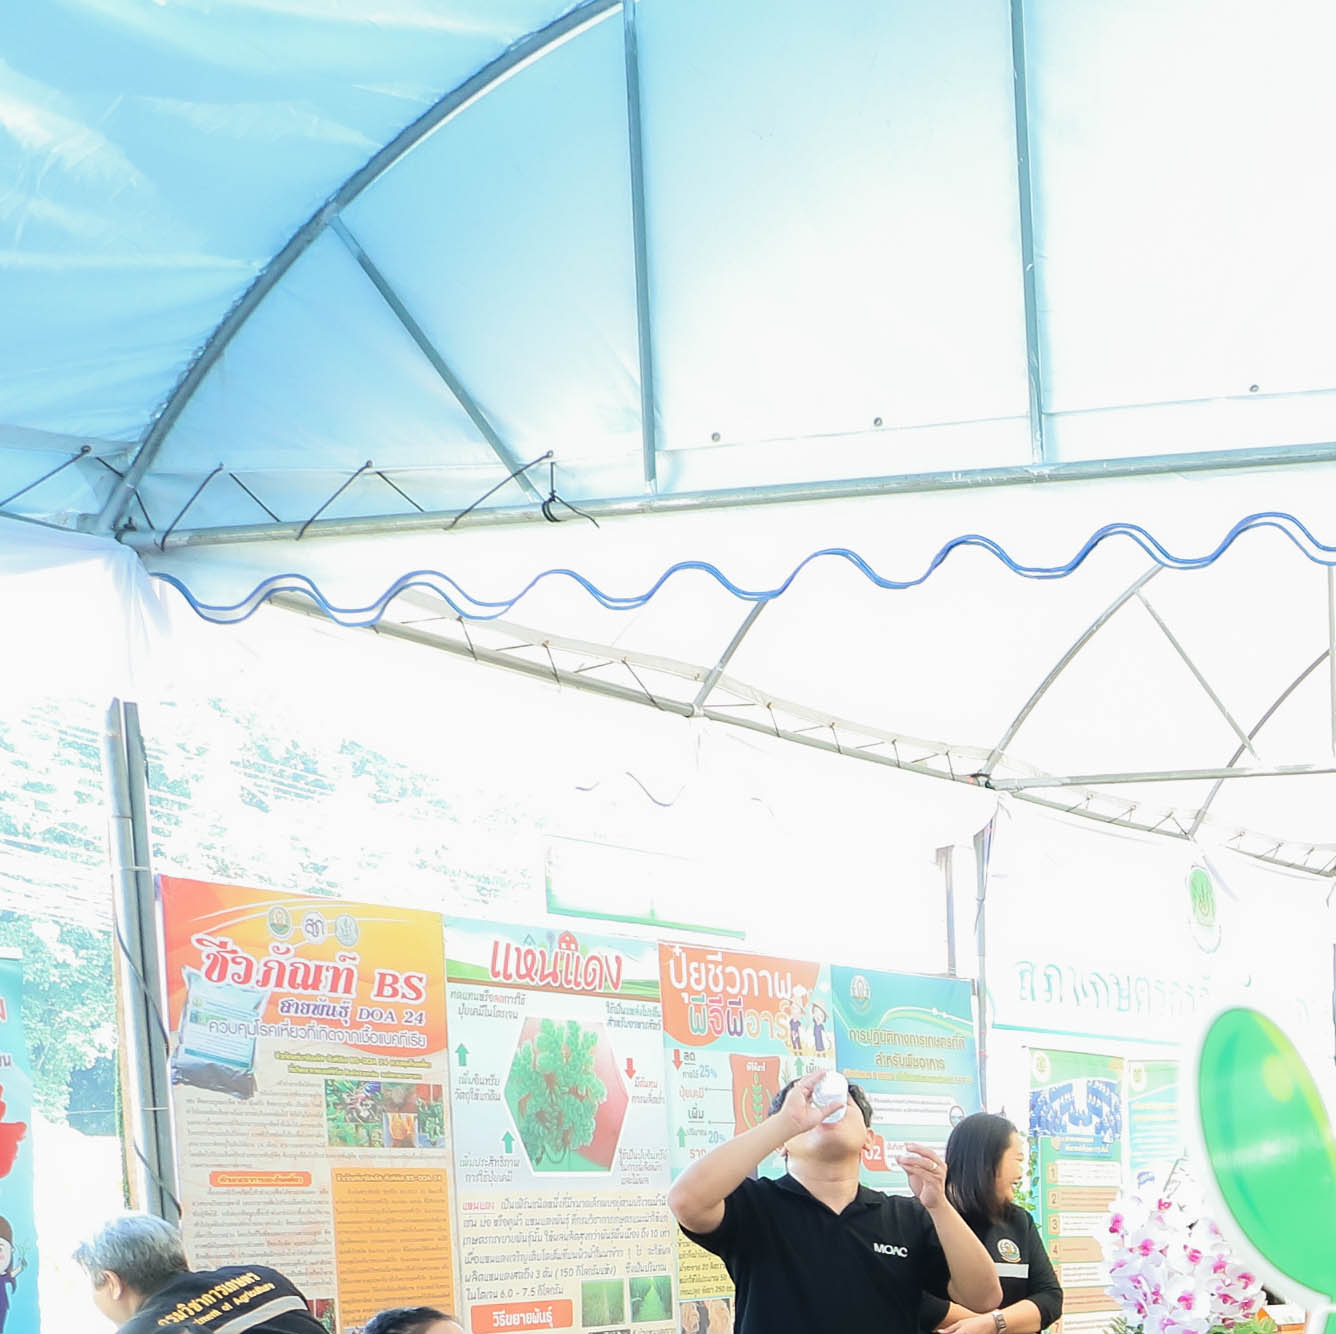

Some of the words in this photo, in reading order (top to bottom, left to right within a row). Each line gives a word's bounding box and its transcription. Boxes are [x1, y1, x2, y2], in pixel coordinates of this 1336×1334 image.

[194, 937, 356, 995] ชีวภัณฑ์
[374, 971, 426, 1001] BS
[490, 940, 623, 991] แหนแดง
[669, 945, 792, 1004] ปุ๋ยชีวภาพ
[279, 998, 351, 1024] สายพันธุ์
[358, 1009, 396, 1023] DOA
[403, 1010, 425, 1024] 24
[689, 994, 791, 1042] พีจีพีอาร์
[873, 1242, 909, 1258] MOAC
